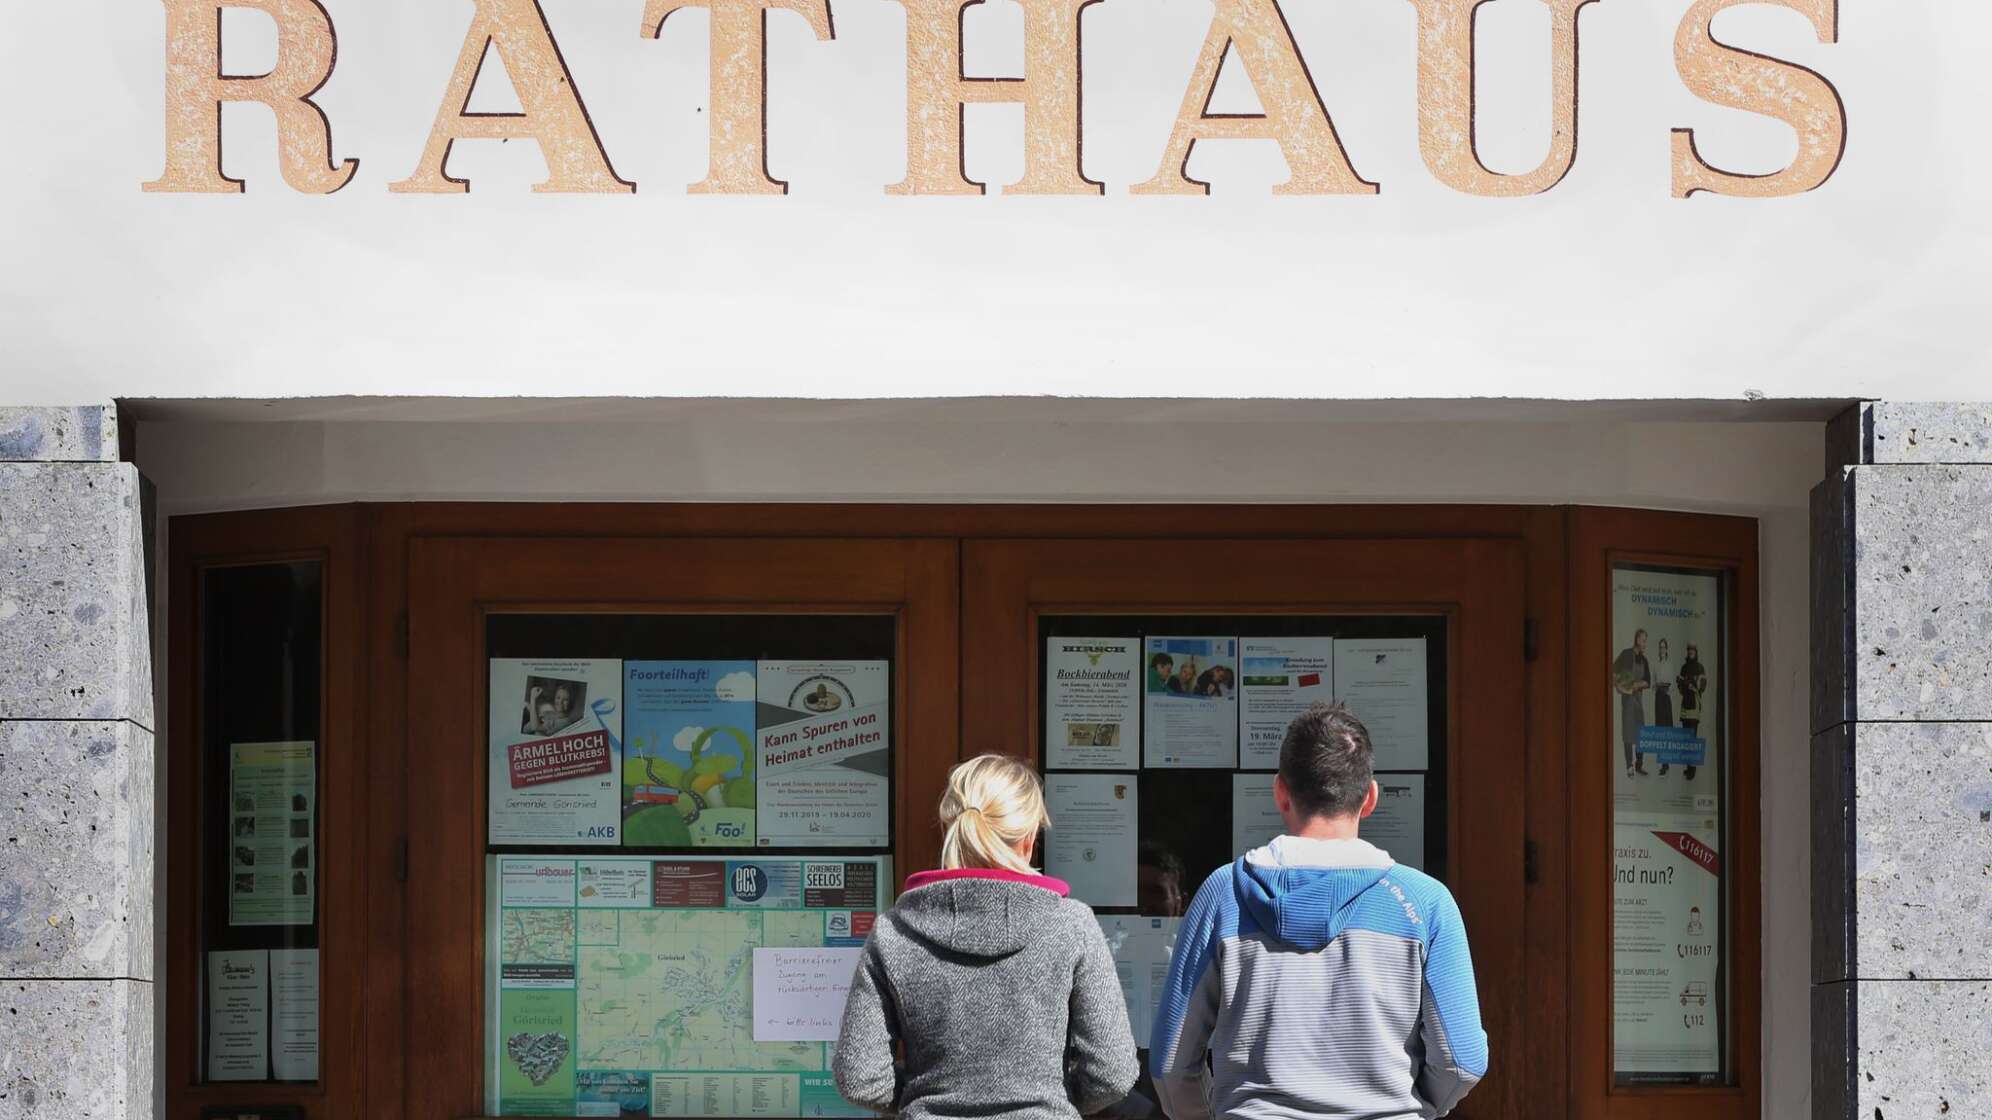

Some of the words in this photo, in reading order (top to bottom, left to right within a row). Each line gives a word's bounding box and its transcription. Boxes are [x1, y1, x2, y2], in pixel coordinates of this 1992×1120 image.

[142, 0, 1847, 198] RATHAUS
[1632, 593, 1677, 605] DYNAMISCH
[1648, 606, 1693, 618] DYNAMISCH
[630, 668, 710, 684] Foorteilhaft!
[1057, 669, 1131, 680] Bockbierabend
[764, 731, 798, 748] Kann
[802, 719, 848, 740] Spuren
[852, 713, 877, 726] von
[513, 743, 561, 761] ÄRMEL
[568, 735, 605, 752] HOCH
[765, 745, 813, 767] Heimat
[816, 731, 881, 755] enthalten
[514, 757, 551, 770] GEGEN
[553, 748, 606, 765] BLUTKREBS!
[505, 798, 548, 809] Gemeinde
[587, 826, 615, 839] AKB
[1615, 846, 1635, 858] raxis
[1686, 840, 1714, 865] 116117
[807, 873, 842, 887] SEELOS
[1640, 866, 1674, 884] nun?
[1685, 945, 1712, 956] 116117
[1691, 1015, 1704, 1026] 112
